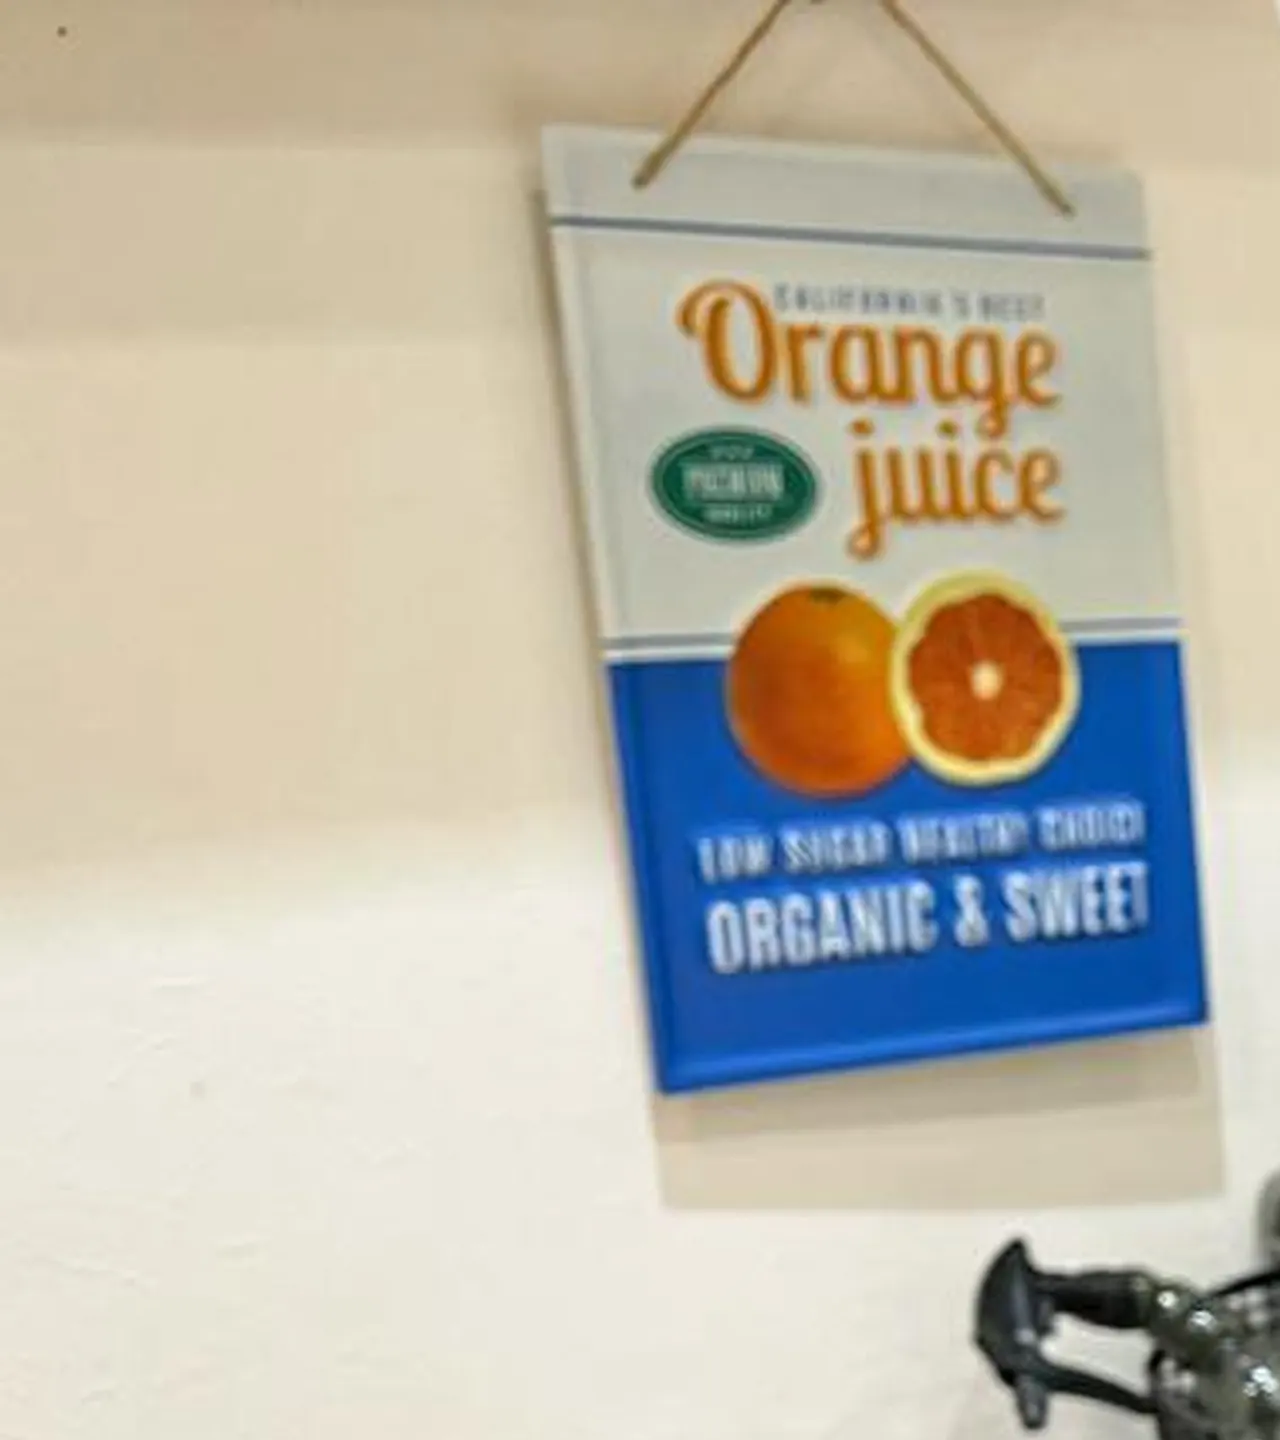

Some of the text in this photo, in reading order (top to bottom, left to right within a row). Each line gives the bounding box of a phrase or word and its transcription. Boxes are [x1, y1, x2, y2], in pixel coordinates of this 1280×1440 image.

[676, 281, 1062, 441] Orange
[847, 417, 1065, 562] juice
[708, 858, 1148, 974] ORGANIC & SWEET
